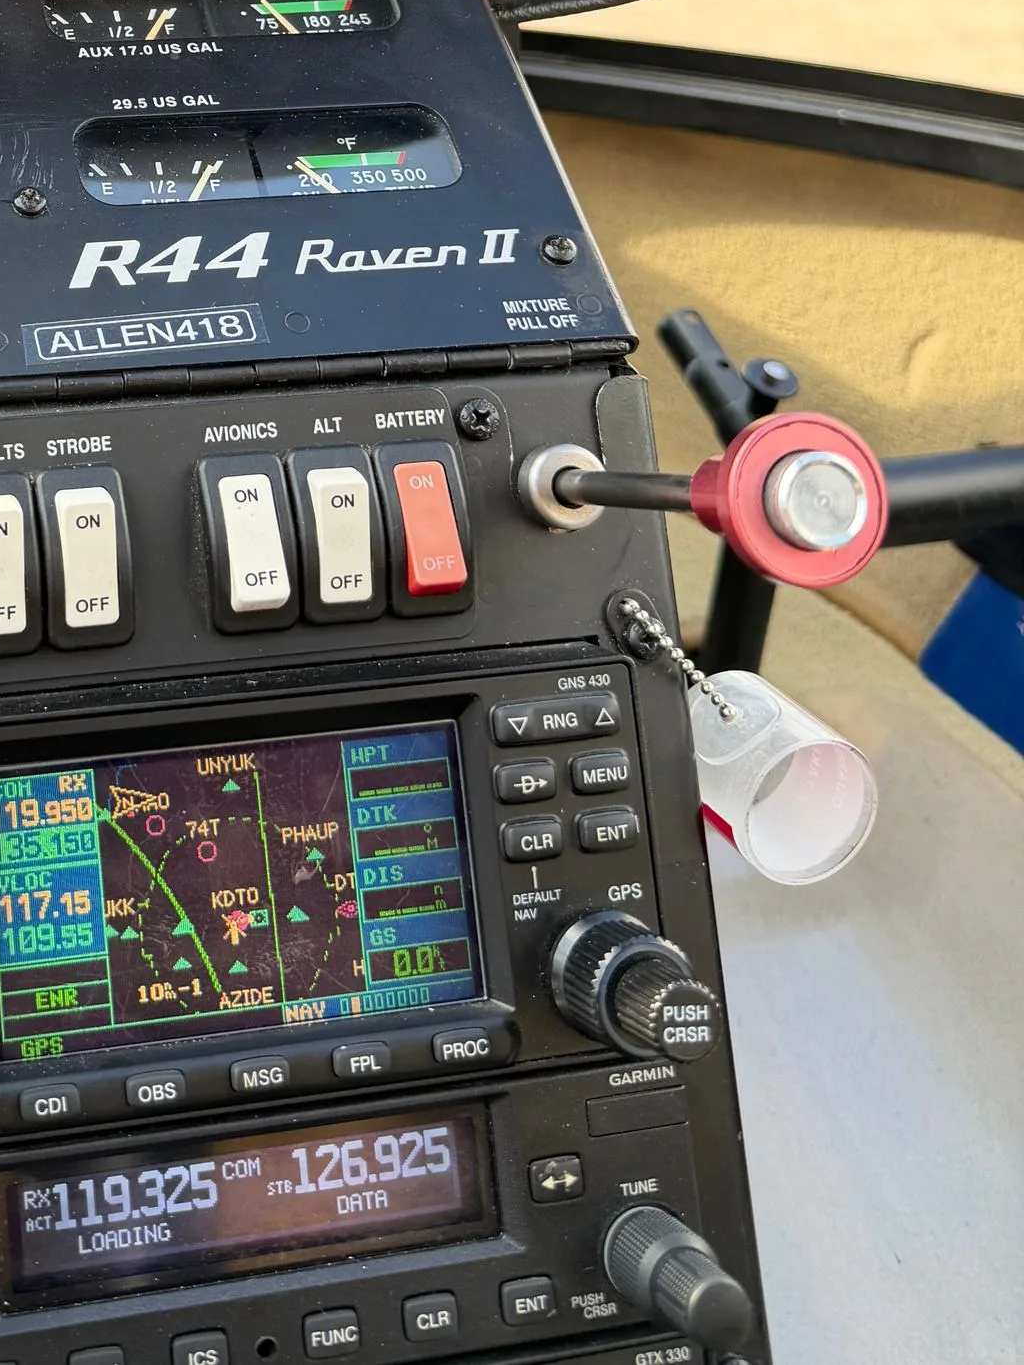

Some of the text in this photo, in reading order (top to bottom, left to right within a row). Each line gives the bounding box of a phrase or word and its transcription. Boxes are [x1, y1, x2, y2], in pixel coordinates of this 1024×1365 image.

[78, 41, 224, 59] AUX 17.0 US GAL
[112, 94, 220, 111] 29.5 US GAL
[68, 228, 520, 290] R44 Raven II
[502, 298, 570, 315] MIXTURE
[507, 313, 578, 332] PULL OFF
[48, 313, 245, 356] ALLEN418
[313, 417, 343, 435] ALT
[375, 409, 446, 430] BATTERY
[203, 422, 278, 444] AVIONICS
[46, 435, 112, 457] STROBE
[409, 474, 435, 490] ON
[234, 487, 259, 504] ON
[422, 555, 456, 572] OFF
[244, 570, 279, 587] OFF
[557, 674, 611, 690] GNS 430
[543, 713, 578, 730] RNG
[583, 765, 628, 784] MENU
[281, 821, 340, 846] PHAUP
[521, 834, 554, 851] CLR
[596, 824, 629, 841] ENT
[608, 883, 643, 901] GPS
[0, 890, 92, 925] 117.15
[2, 922, 93, 957] 109.55
[35, 988, 79, 1011] ENR
[219, 986, 275, 1010] AZIDE
[663, 1004, 708, 1022] PUSH
[662, 1026, 710, 1043] CRSR
[443, 1038, 490, 1060] PROC
[351, 1054, 382, 1073] FPL
[243, 1067, 284, 1088] MSG
[608, 1065, 675, 1087] GARMIN
[137, 1083, 177, 1104] OBS
[34, 1096, 68, 1116] CDI
[291, 1127, 451, 1195] 126.925
[52, 1162, 219, 1230] 119.325
[619, 1177, 659, 1197] TUNE
[336, 1189, 389, 1215] DATA
[77, 1223, 172, 1254] LOADING
